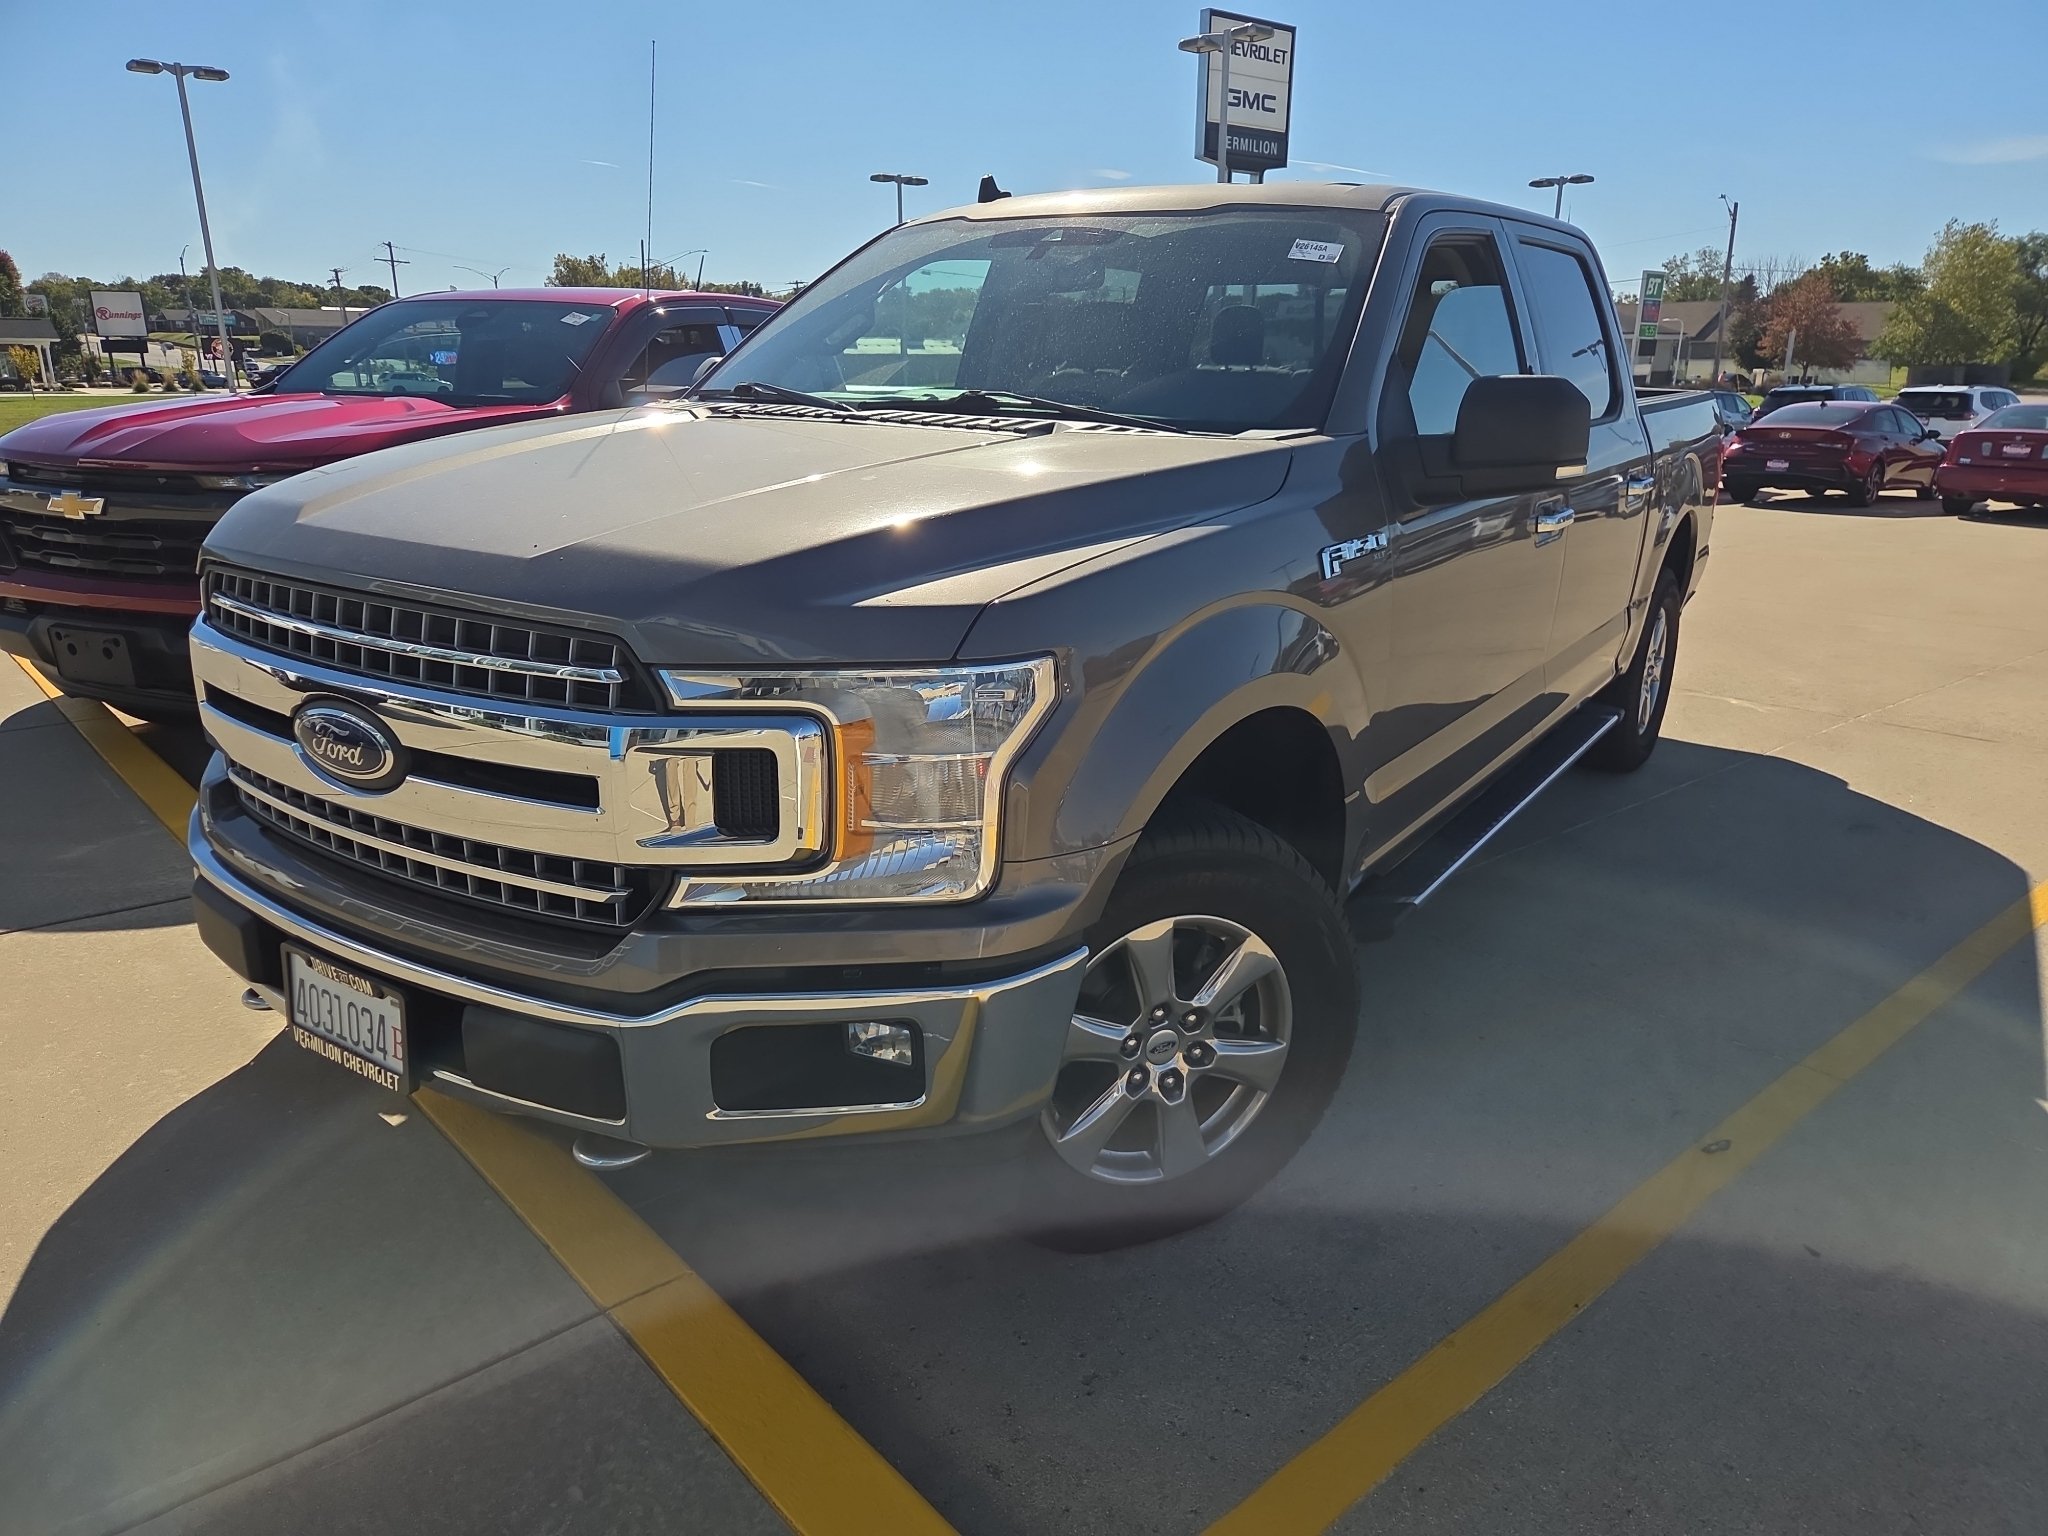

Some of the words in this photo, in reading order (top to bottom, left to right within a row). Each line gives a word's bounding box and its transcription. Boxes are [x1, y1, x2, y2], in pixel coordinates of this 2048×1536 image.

[1226, 135, 1278, 155] ERMILION
[95, 306, 143, 321] Runnings
[311, 722, 364, 766] Ford
[310, 956, 339, 982] DRIVE
[348, 973, 374, 997] COM
[296, 977, 388, 1062] 4031034
[292, 1025, 343, 1065] VERMILION
[342, 1051, 400, 1092] CHEVROLET
